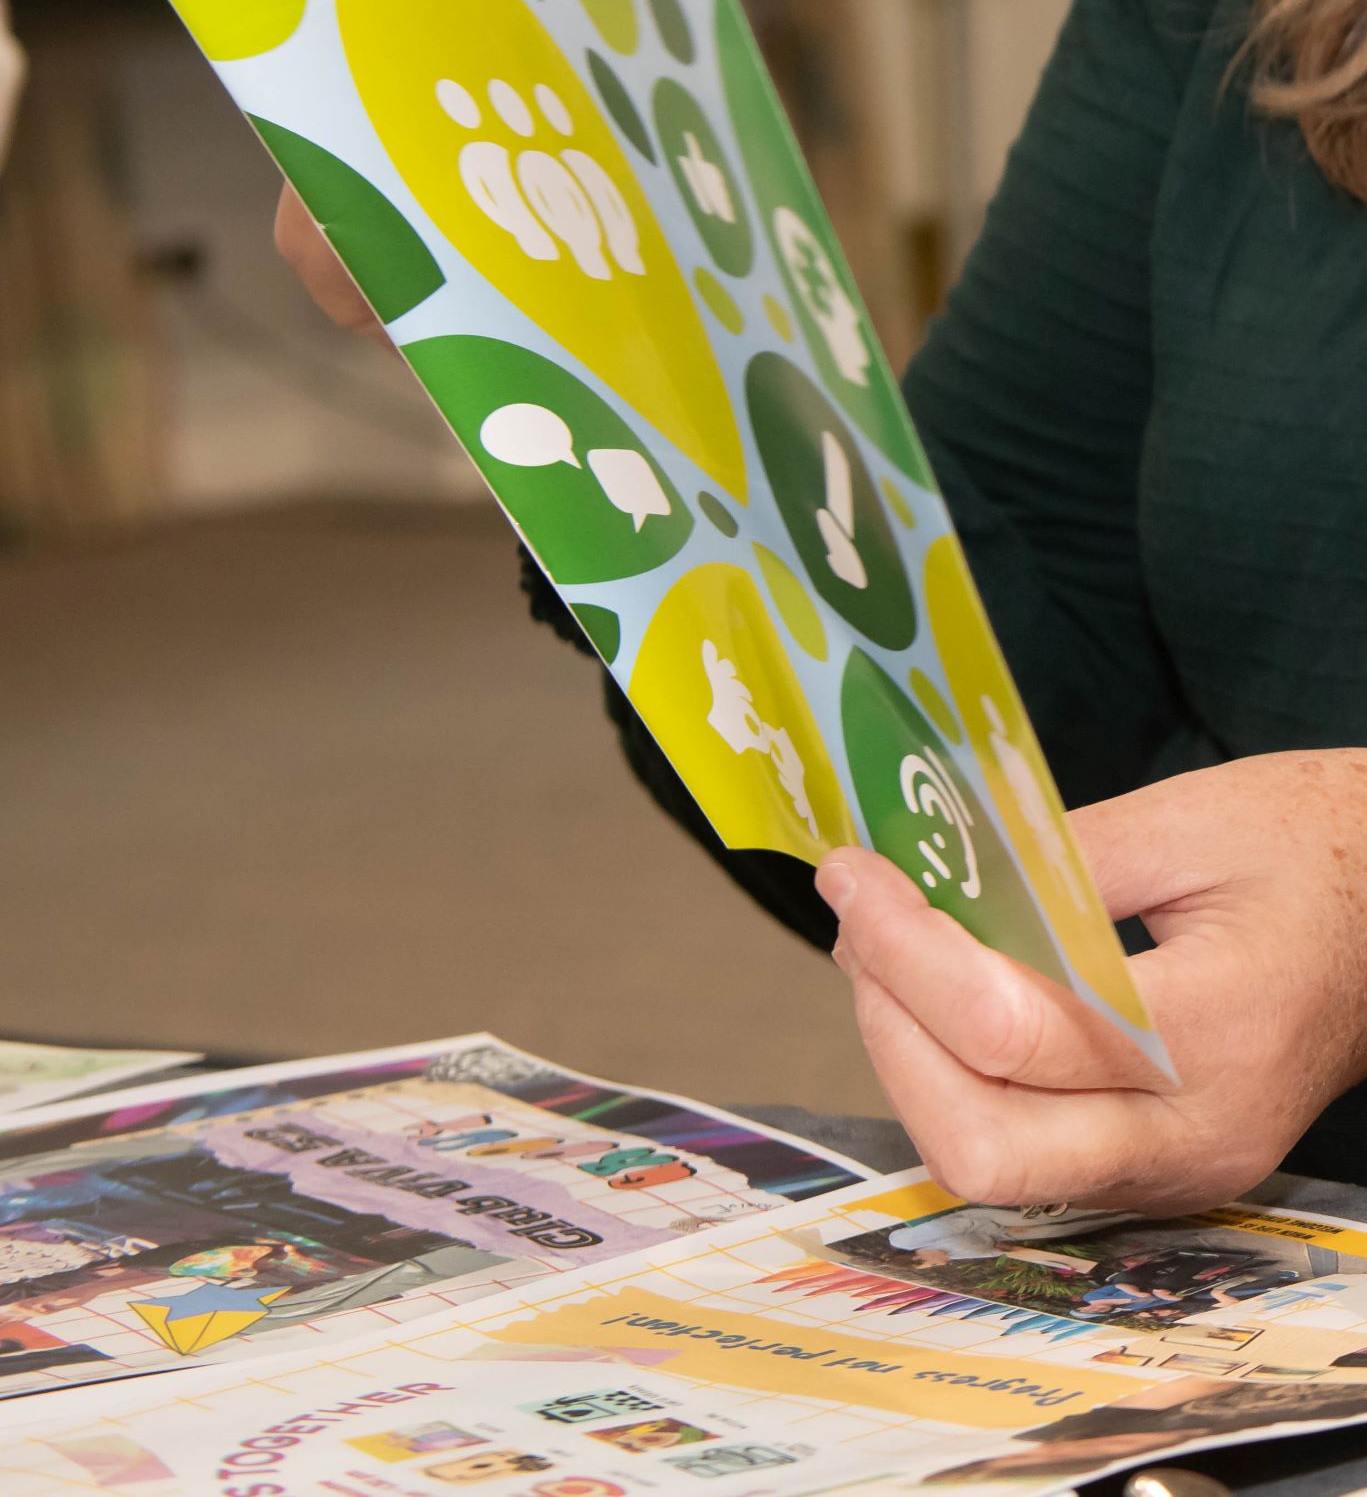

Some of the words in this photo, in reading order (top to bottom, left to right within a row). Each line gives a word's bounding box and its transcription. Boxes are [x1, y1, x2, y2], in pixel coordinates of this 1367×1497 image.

[601, 1312, 825, 1360] perfection!
[821, 1348, 903, 1374] not
[913, 1371, 1083, 1406] Progress
